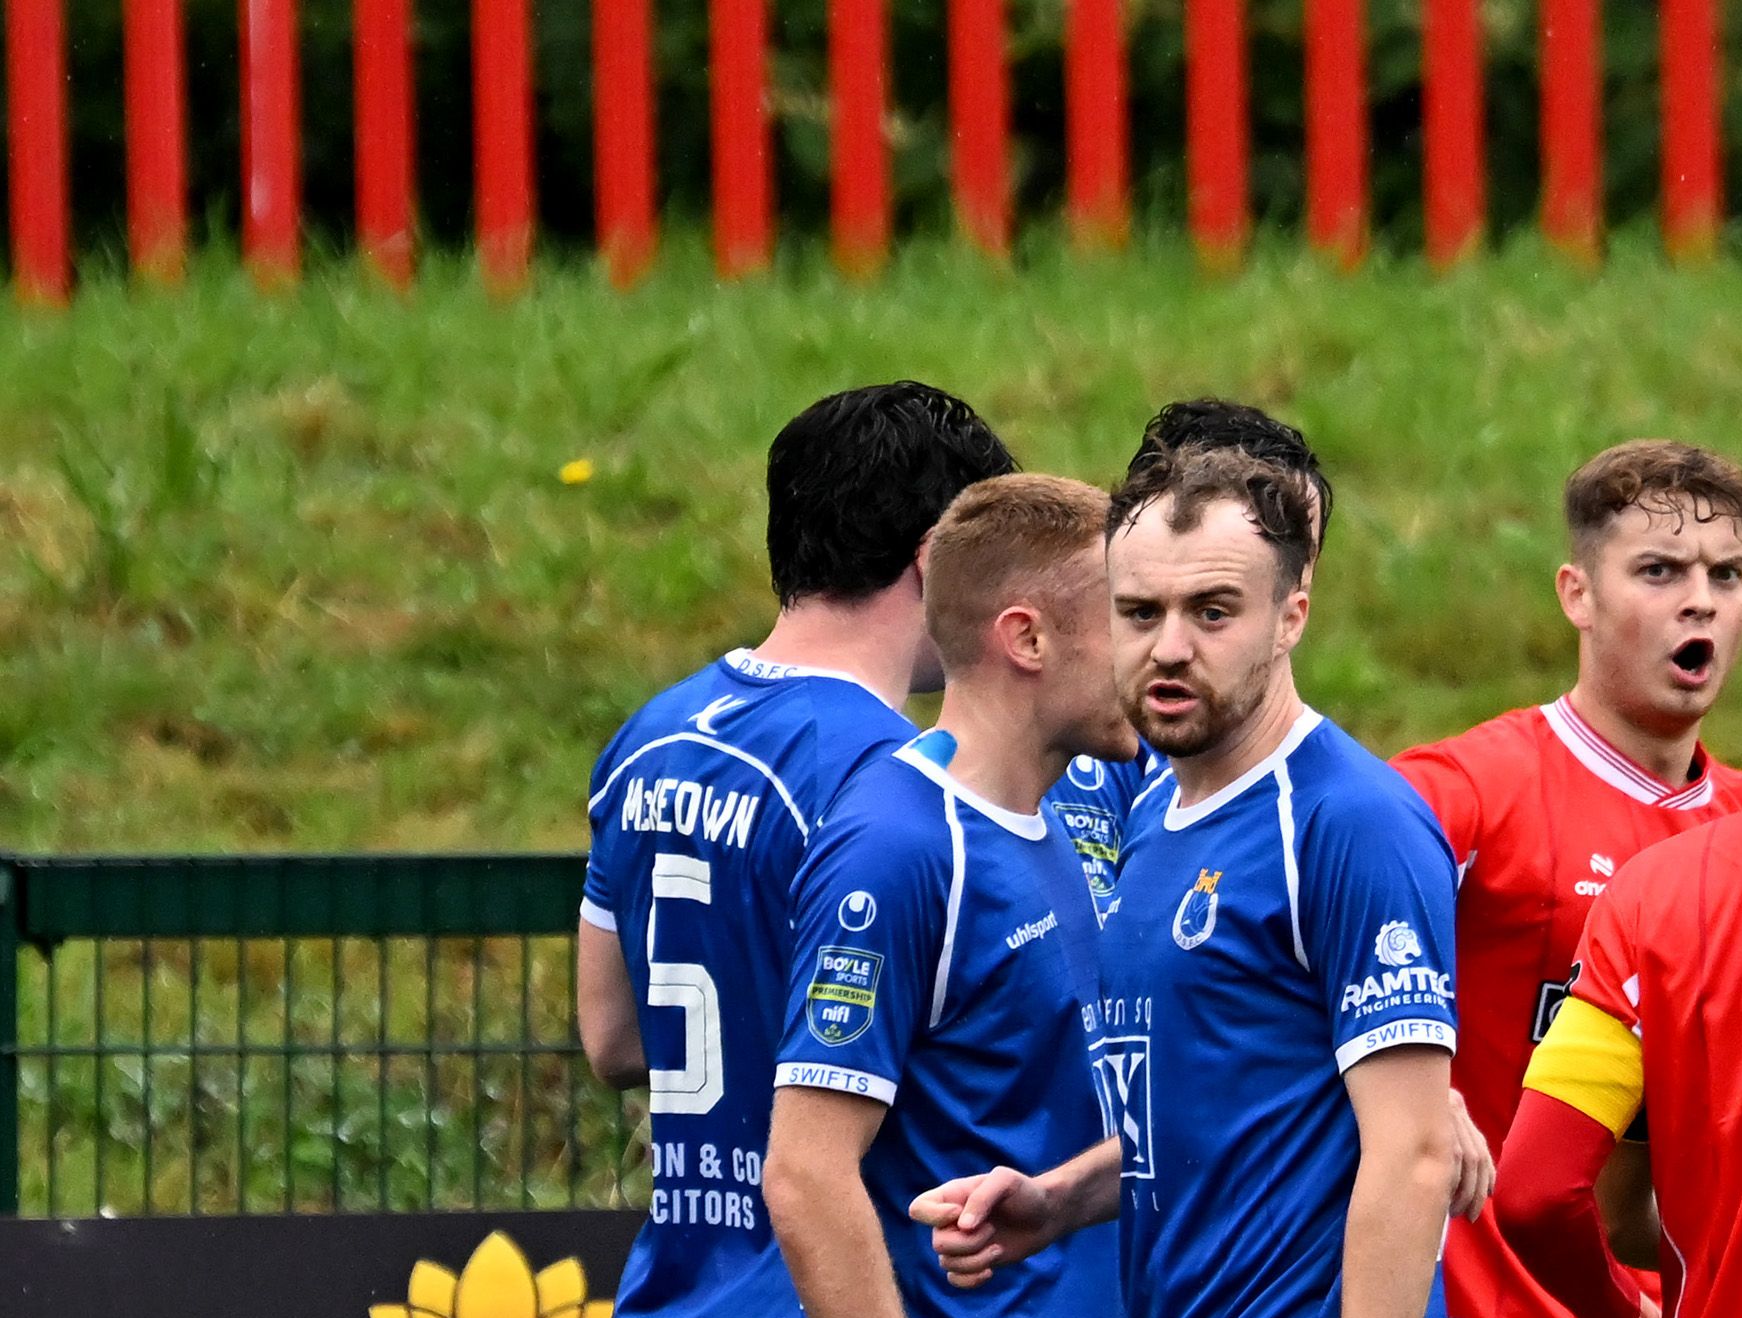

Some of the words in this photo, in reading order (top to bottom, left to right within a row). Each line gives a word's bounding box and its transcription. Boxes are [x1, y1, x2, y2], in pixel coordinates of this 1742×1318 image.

[1005, 909, 1059, 950] uhlsport
[648, 853, 724, 1114] 5
[823, 957, 870, 975] BOYLE
[1340, 967, 1455, 1013] RAMTEC
[822, 1006, 850, 1023] nifl
[1366, 1022, 1444, 1049] SWIFTS
[789, 1066, 870, 1094] SWIFTS
[699, 1143, 723, 1179] &
[732, 1147, 761, 1186] CO
[650, 1188, 755, 1230] CITORS
